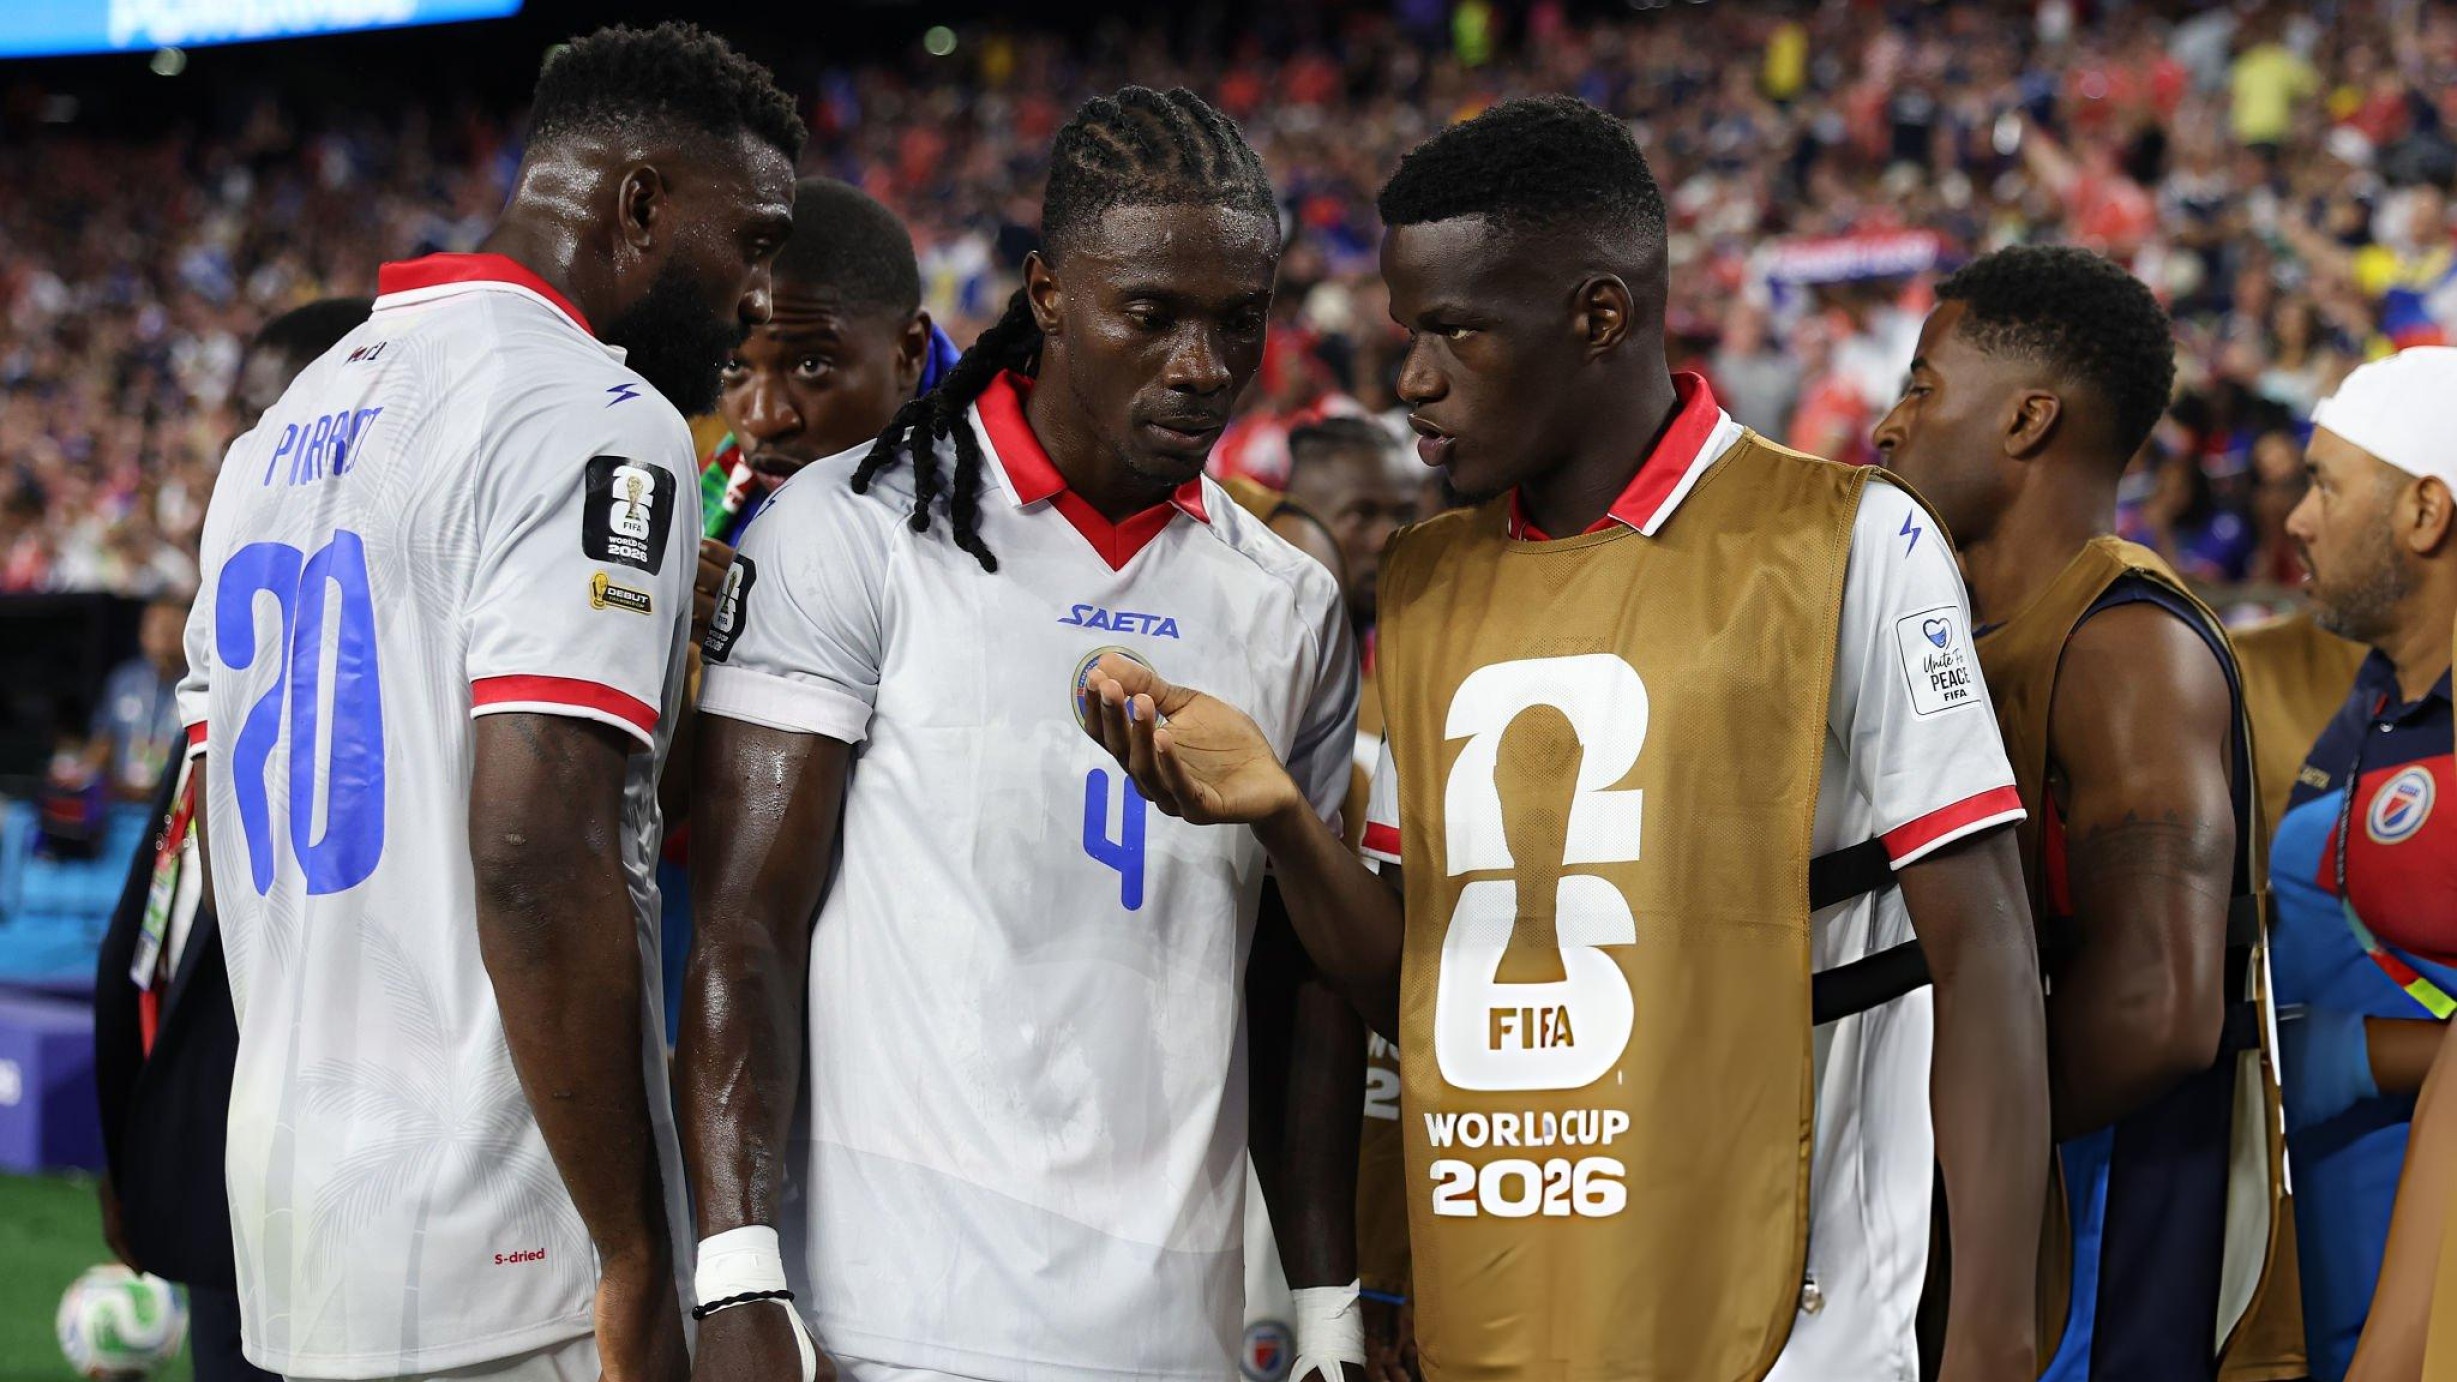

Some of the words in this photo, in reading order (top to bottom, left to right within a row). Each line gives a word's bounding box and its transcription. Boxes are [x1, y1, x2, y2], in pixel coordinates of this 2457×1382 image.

[623, 522, 642, 533] FIFA
[607, 544, 648, 563] 2026
[608, 536, 638, 547] WORLD
[607, 587, 649, 604] DEBUT
[1057, 604, 1180, 639] SAETA
[1923, 652, 1954, 674] Unite
[1930, 666, 1971, 692] PEACE
[1943, 689, 1968, 702] FIFA
[215, 528, 386, 897] 20
[1083, 768, 1147, 911] 4
[1489, 1004, 1575, 1051] FIFA
[1424, 1111, 1558, 1149] WORLD
[1560, 1109, 1631, 1146] CUP
[1429, 1156, 1628, 1218] 2026
[494, 1247, 546, 1265] S-dried
